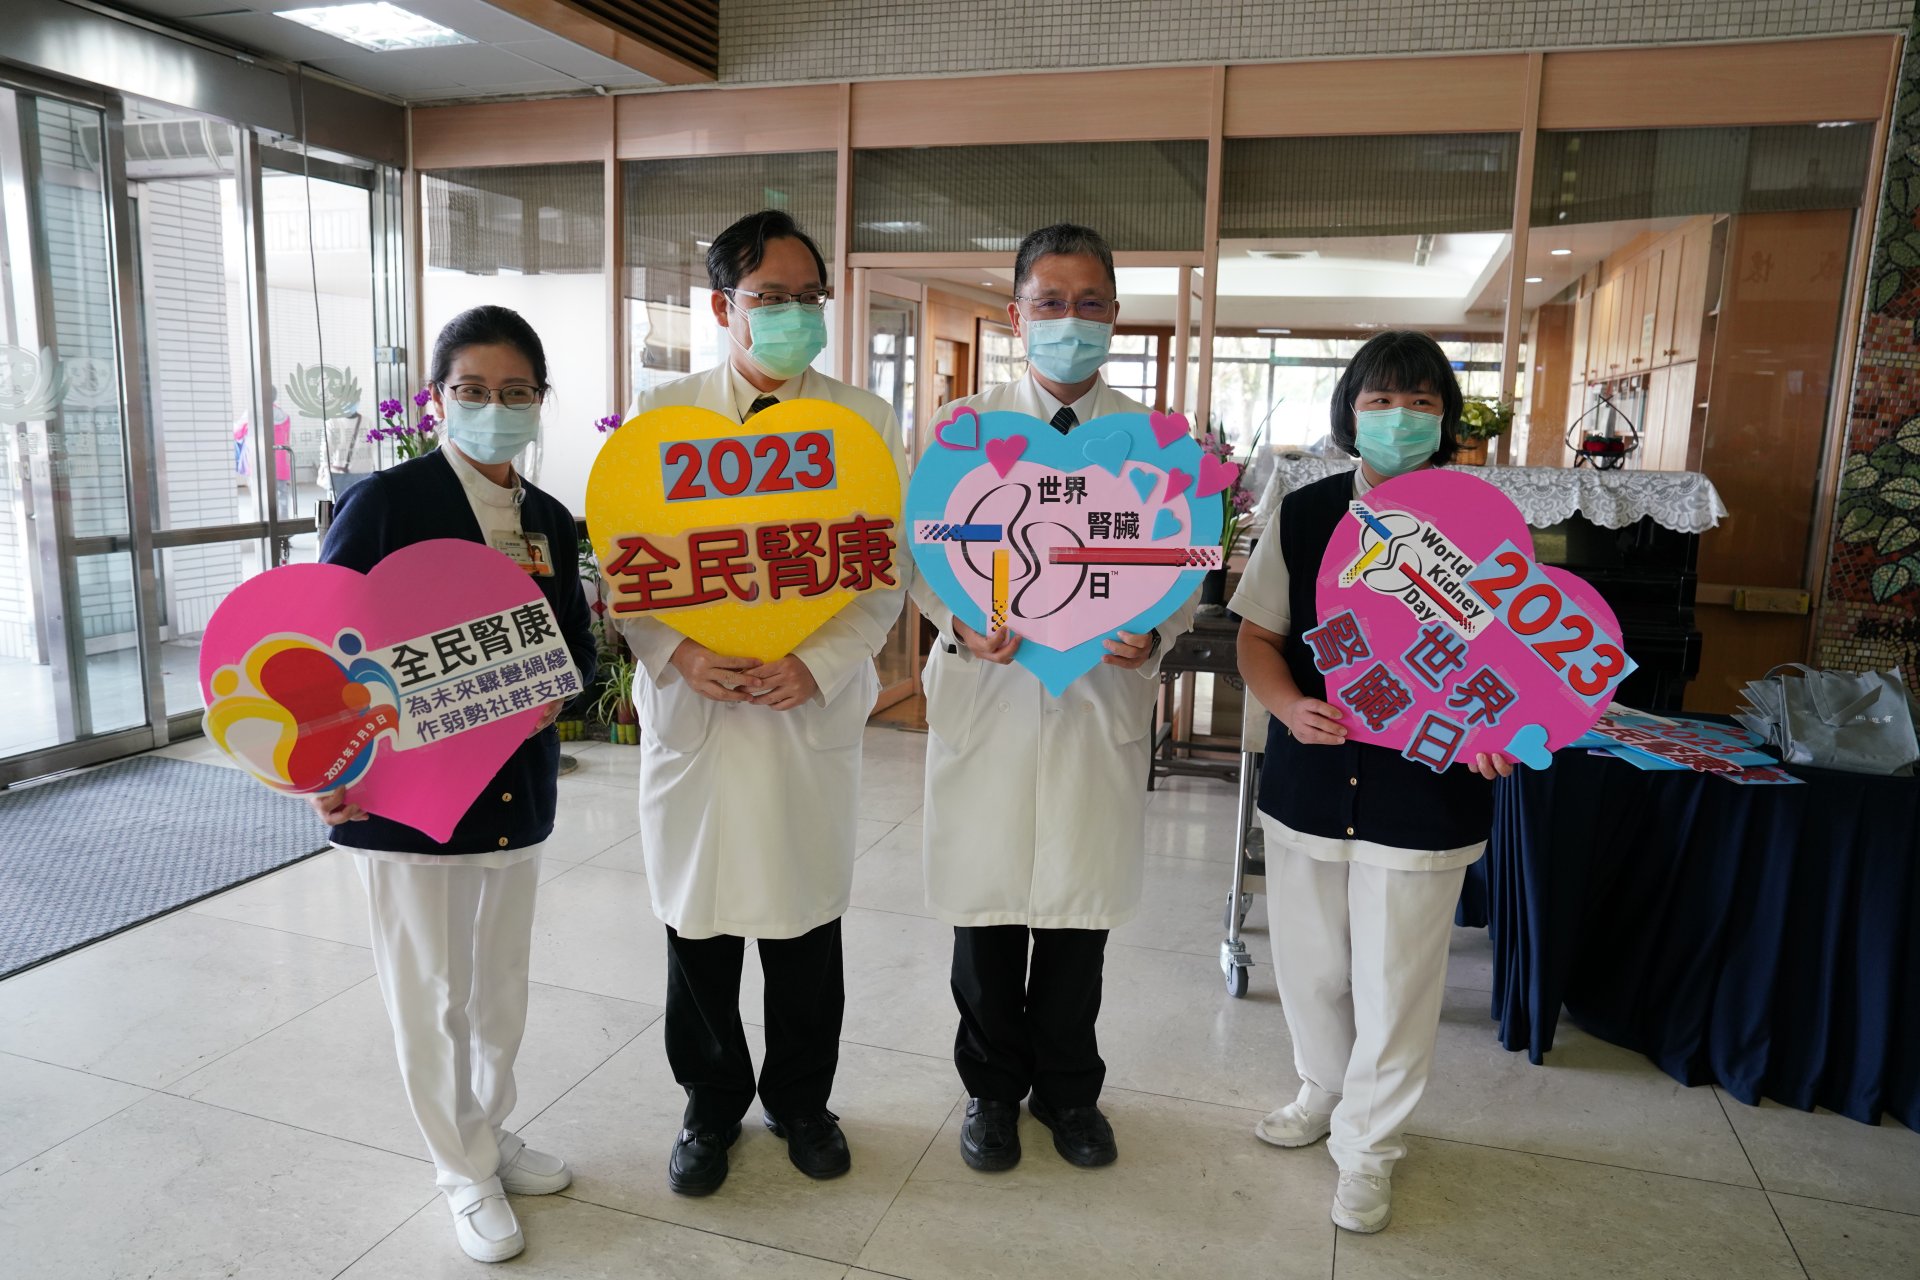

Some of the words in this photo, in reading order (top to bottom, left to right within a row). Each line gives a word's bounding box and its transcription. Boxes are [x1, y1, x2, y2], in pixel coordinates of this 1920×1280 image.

[665, 432, 834, 500] 2023
[1038, 475, 1088, 505] 世界
[1088, 511, 1139, 540] 腎臟
[1421, 527, 1473, 578] World
[606, 514, 896, 614] 全民腎康
[1090, 573, 1109, 599] 日
[1427, 564, 1485, 619] Kidney
[1403, 588, 1436, 621] Day
[1467, 551, 1625, 697] 2023
[390, 602, 556, 687] 全民腎康
[405, 647, 567, 718] 為未來驟變綢繆
[417, 671, 579, 743] 作弱勢社群支援
